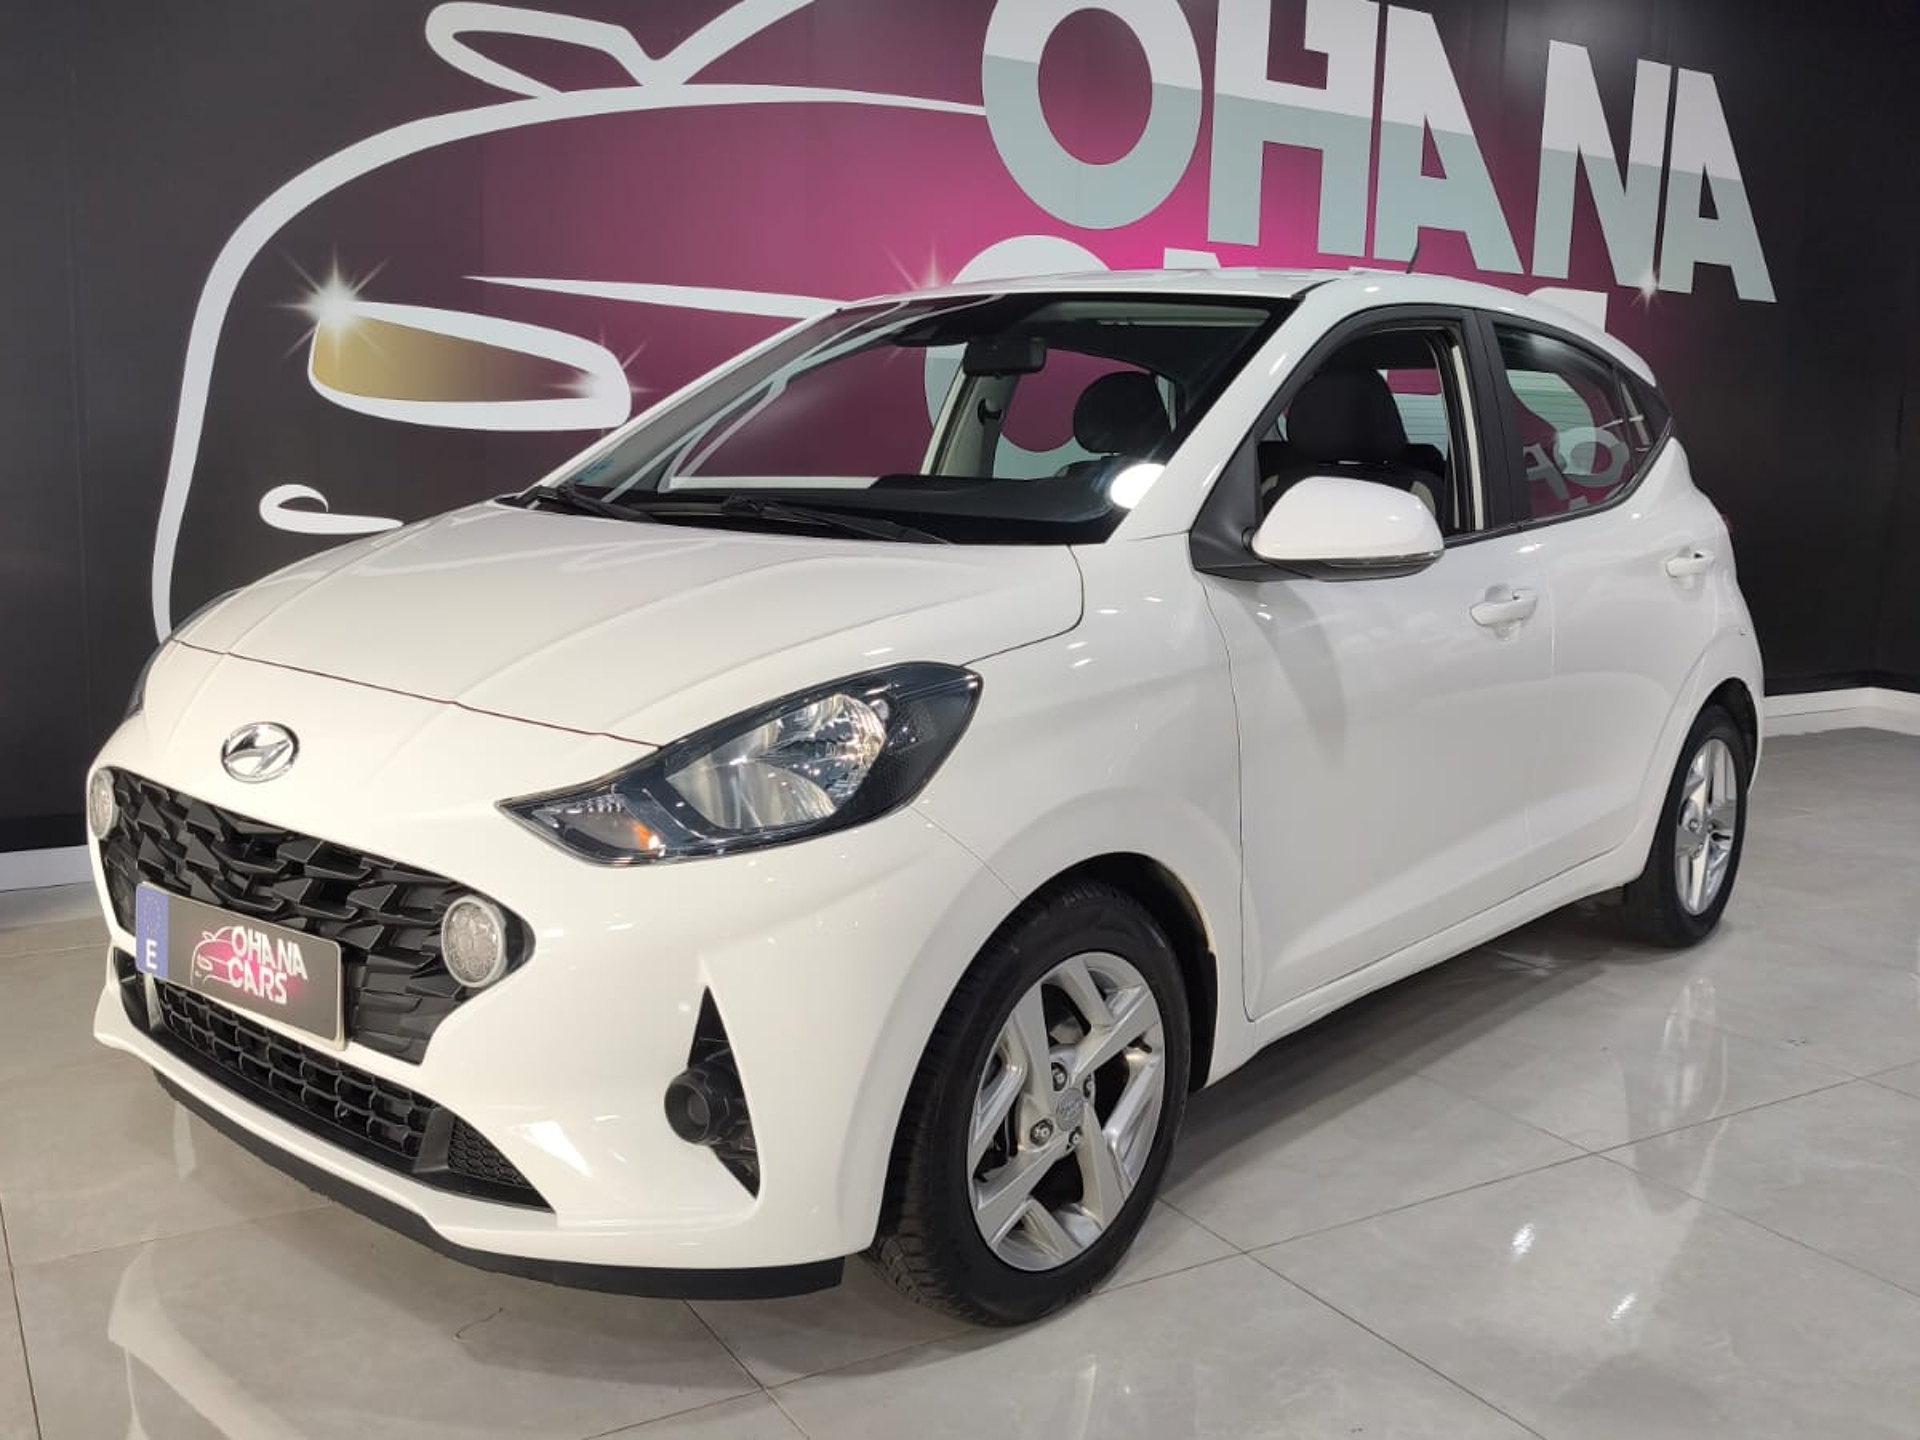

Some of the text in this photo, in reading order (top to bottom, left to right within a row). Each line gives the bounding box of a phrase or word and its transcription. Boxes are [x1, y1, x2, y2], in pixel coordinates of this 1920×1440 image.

[982, 0, 1777, 303] OHANA
[145, 939, 158, 970] E
[231, 926, 308, 980] OHANA
[228, 956, 288, 1005] CARS
